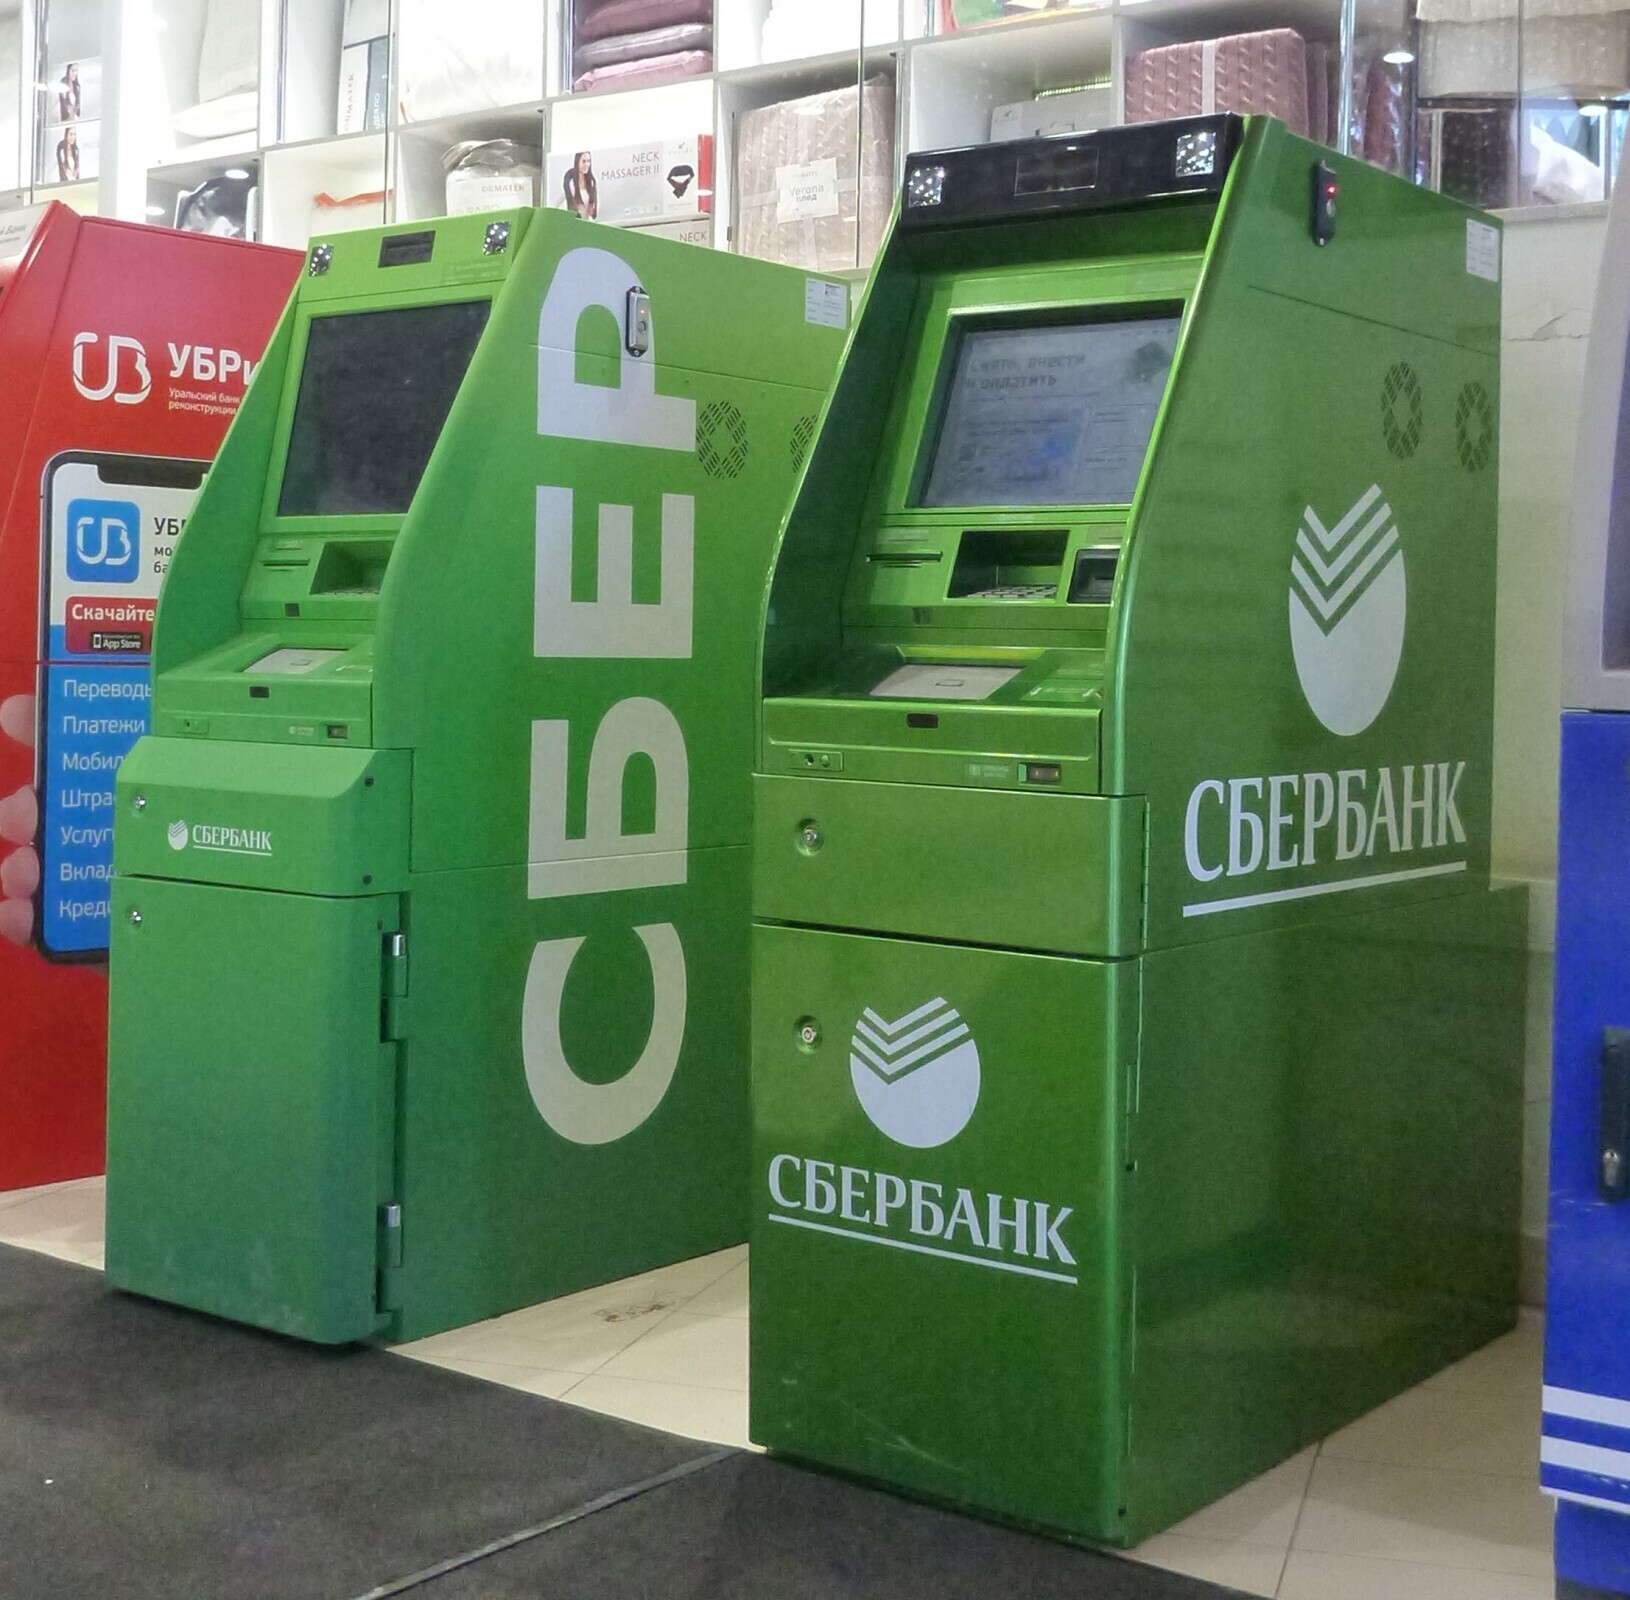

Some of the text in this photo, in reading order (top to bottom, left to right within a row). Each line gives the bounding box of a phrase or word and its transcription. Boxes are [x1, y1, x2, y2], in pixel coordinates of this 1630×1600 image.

[632, 151, 660, 163] NECK
[601, 166, 652, 181] MASSAGER
[481, 184, 525, 194] ORMATEK
[680, 232, 707, 242] NECK
[168, 387, 217, 402] Уральский
[154, 517, 186, 536] УБ
[71, 603, 155, 622] Скачайте
[103, 639, 141, 650] App Store
[521, 247, 697, 1146] СБЕР
[63, 716, 145, 734] Платежи
[62, 789, 116, 811] Штра
[1184, 761, 1467, 882] СБЕРБАНК
[61, 826, 115, 848] Услуг
[192, 825, 272, 851] СБЕРБАНК
[768, 1154, 1077, 1265] СБЕРБАНК
